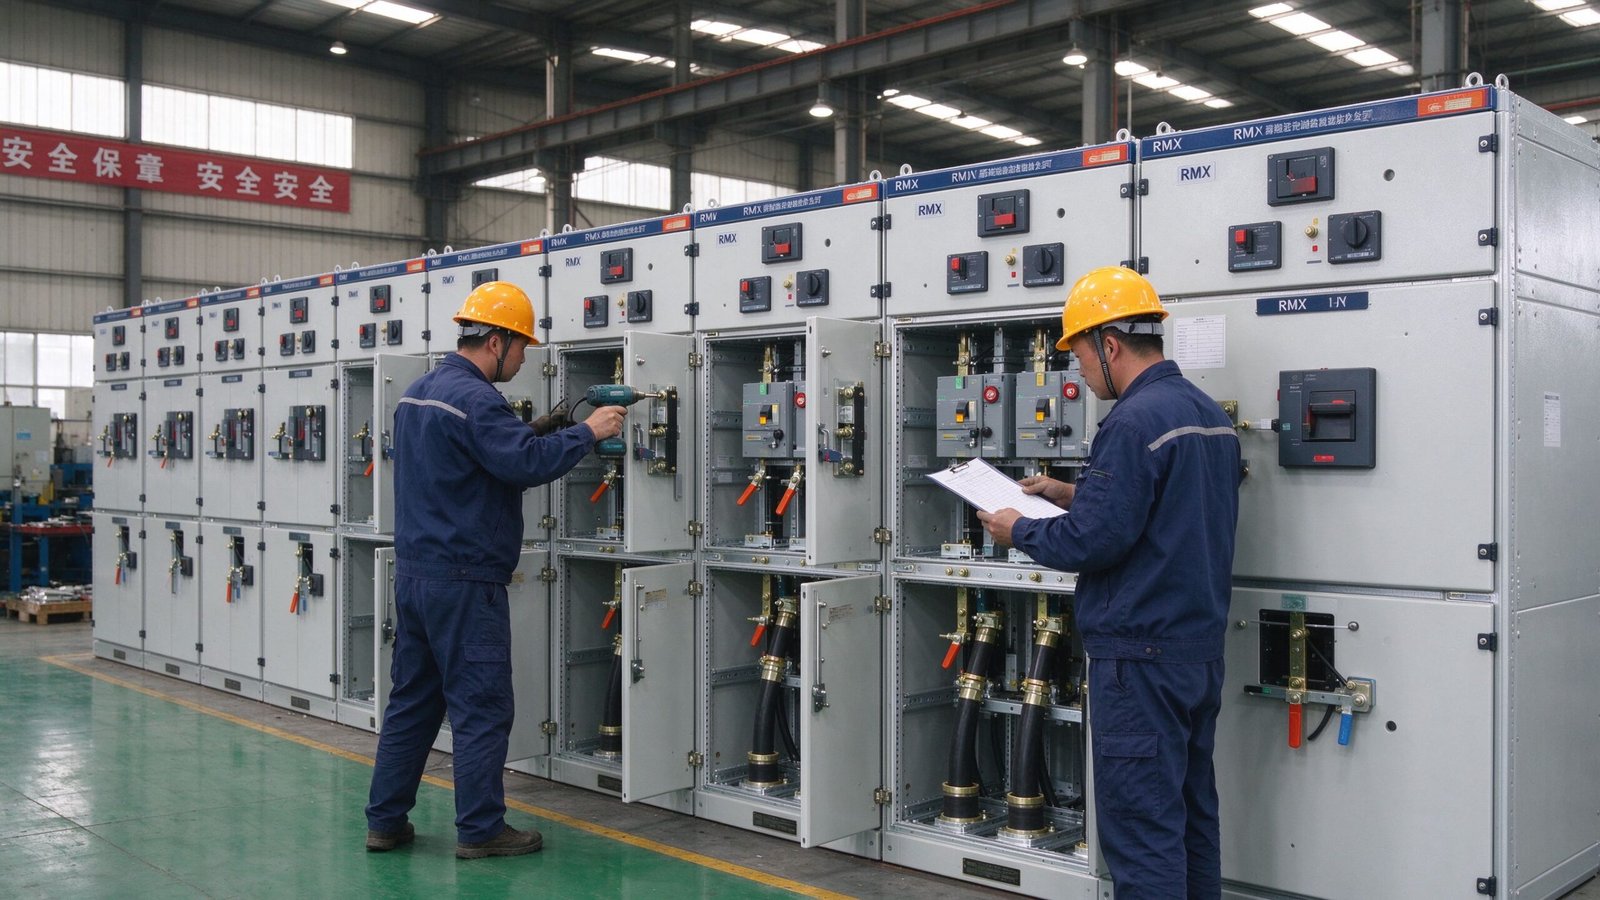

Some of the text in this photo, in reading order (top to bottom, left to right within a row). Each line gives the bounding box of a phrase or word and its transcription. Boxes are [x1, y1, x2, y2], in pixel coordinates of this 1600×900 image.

[1153, 126, 1263, 152] RMX RMX
[3, 136, 335, 204] 安全保章 安全安全
[1181, 165, 1211, 181] RMX
[895, 179, 919, 191] RMX
[743, 205, 762, 216] RMX
[918, 203, 942, 216] RMX
[719, 233, 737, 244] RMX
[565, 256, 581, 267] RMX
[1278, 298, 1307, 312] RMX
